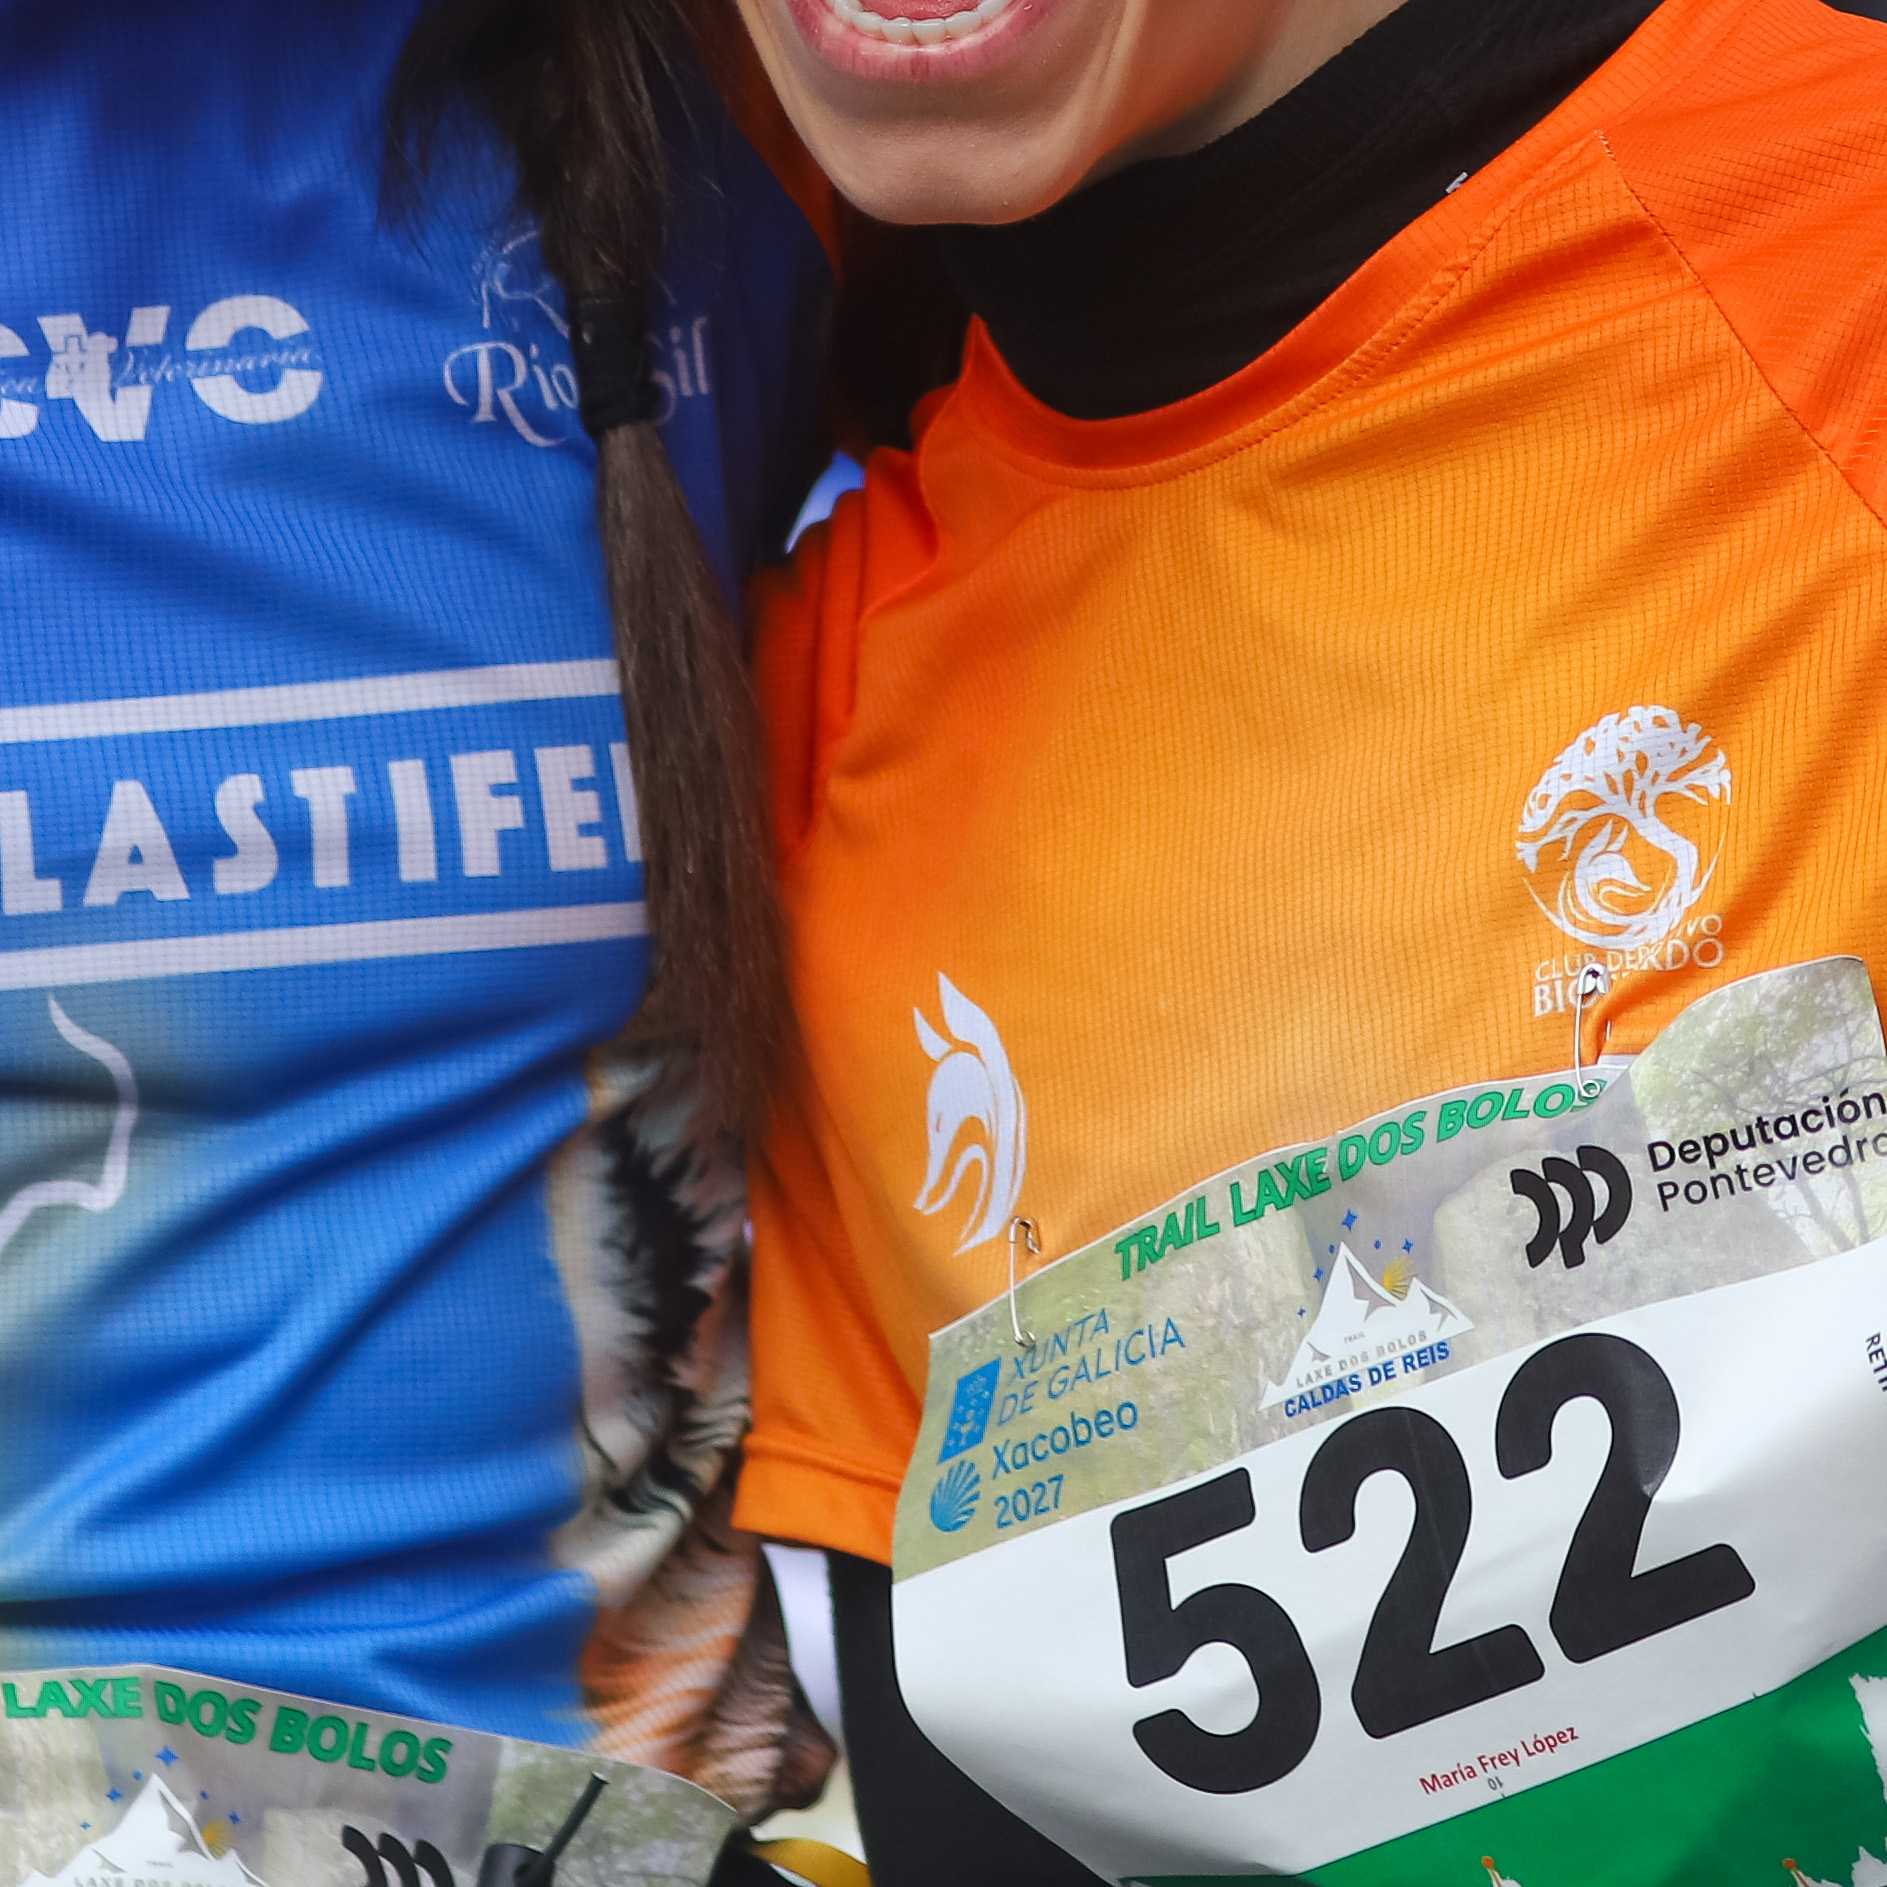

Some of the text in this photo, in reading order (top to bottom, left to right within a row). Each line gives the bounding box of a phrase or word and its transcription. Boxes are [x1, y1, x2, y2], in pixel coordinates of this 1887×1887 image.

[1647, 1088, 1887, 1172] Deputación
[1115, 1195, 1219, 1282] TRAIL
[1230, 1146, 1333, 1227] LAXE
[1338, 1110, 1428, 1183] DOS
[997, 1316, 1186, 1427] DE GALICIA
[1008, 1308, 1109, 1386] XUNTA
[1284, 1340, 1450, 1418] CALDAS DE REIS
[1295, 1362, 1333, 1388] LAXE
[1339, 1351, 1370, 1372] DOS
[991, 1401, 1138, 1479] Xacobeo
[994, 1473, 1064, 1530] 2027
[1110, 1332, 1756, 1795] 522
[1, 1676, 144, 1719] LAXE
[154, 1679, 263, 1746] DOS
[267, 1706, 454, 1785] BOLOS
[1419, 1726, 1579, 1795] María Frey López
